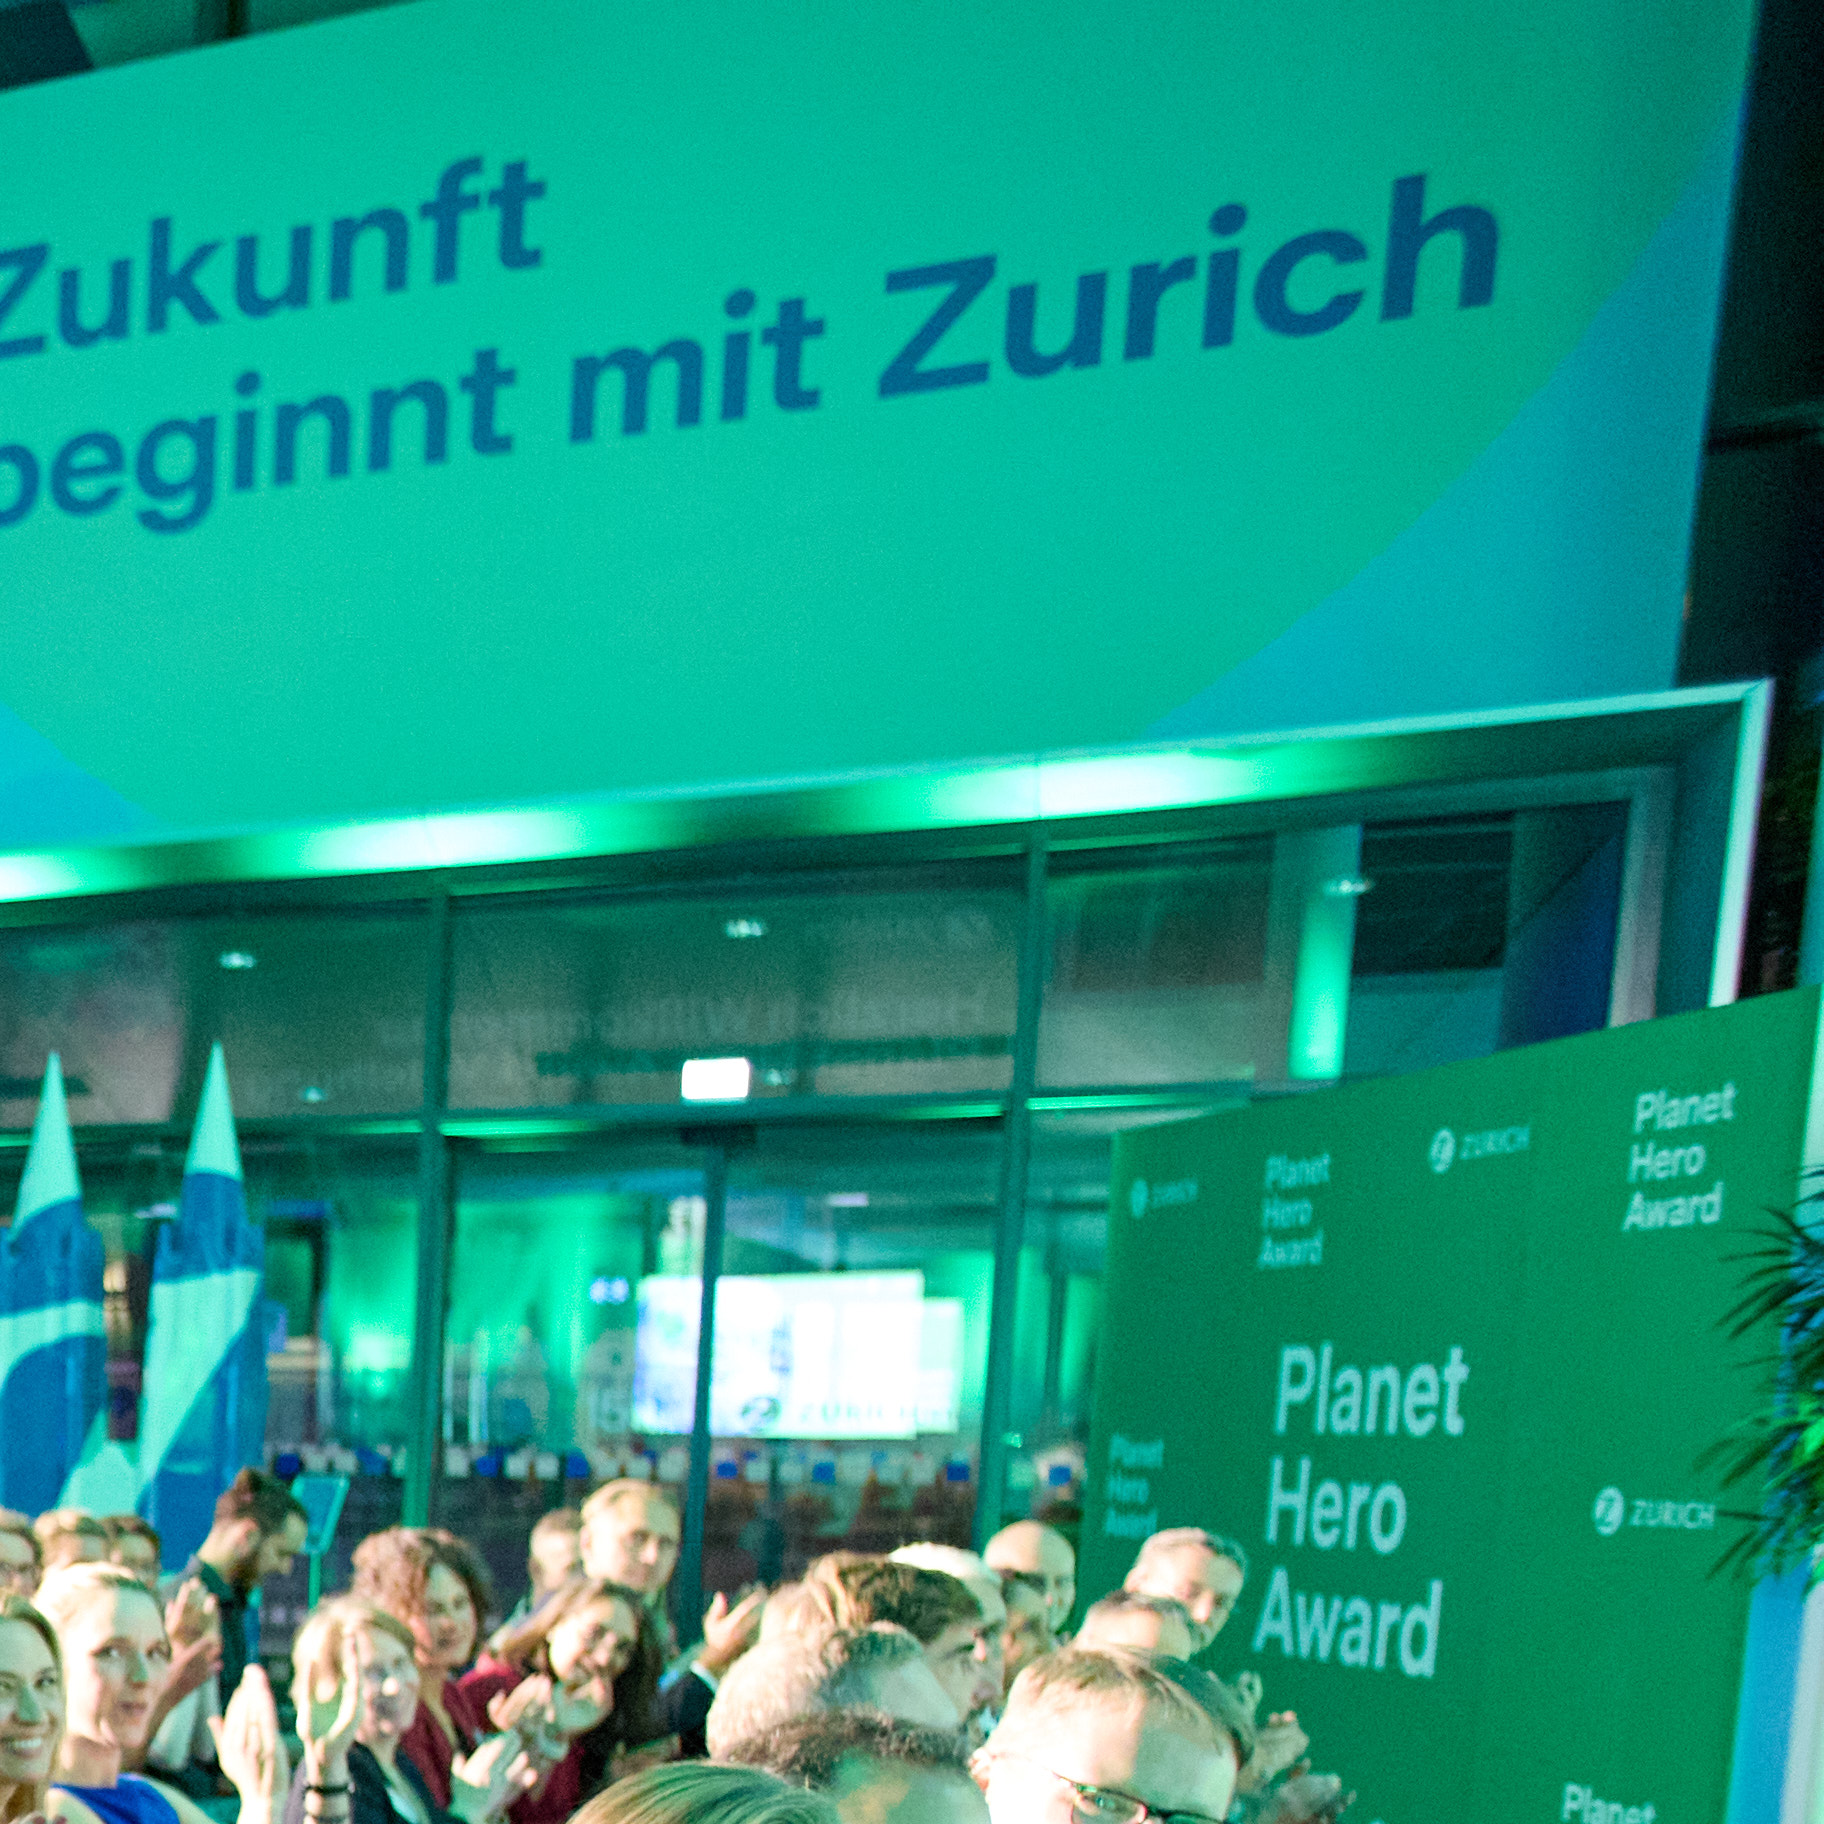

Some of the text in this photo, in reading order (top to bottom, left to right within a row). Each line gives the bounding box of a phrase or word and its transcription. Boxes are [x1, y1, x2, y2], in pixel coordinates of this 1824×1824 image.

[568, 287, 827, 445] mit
[876, 172, 1503, 400] Zurich
[1632, 1080, 1738, 1135] Planet
[1627, 1138, 1706, 1184] Hero
[1621, 1179, 1724, 1233] Award
[1274, 1339, 1471, 1437] Planet
[1265, 1455, 1408, 1554] Hero
[1630, 1499, 1716, 1530] ZURICH
[1253, 1565, 1444, 1680] Award
